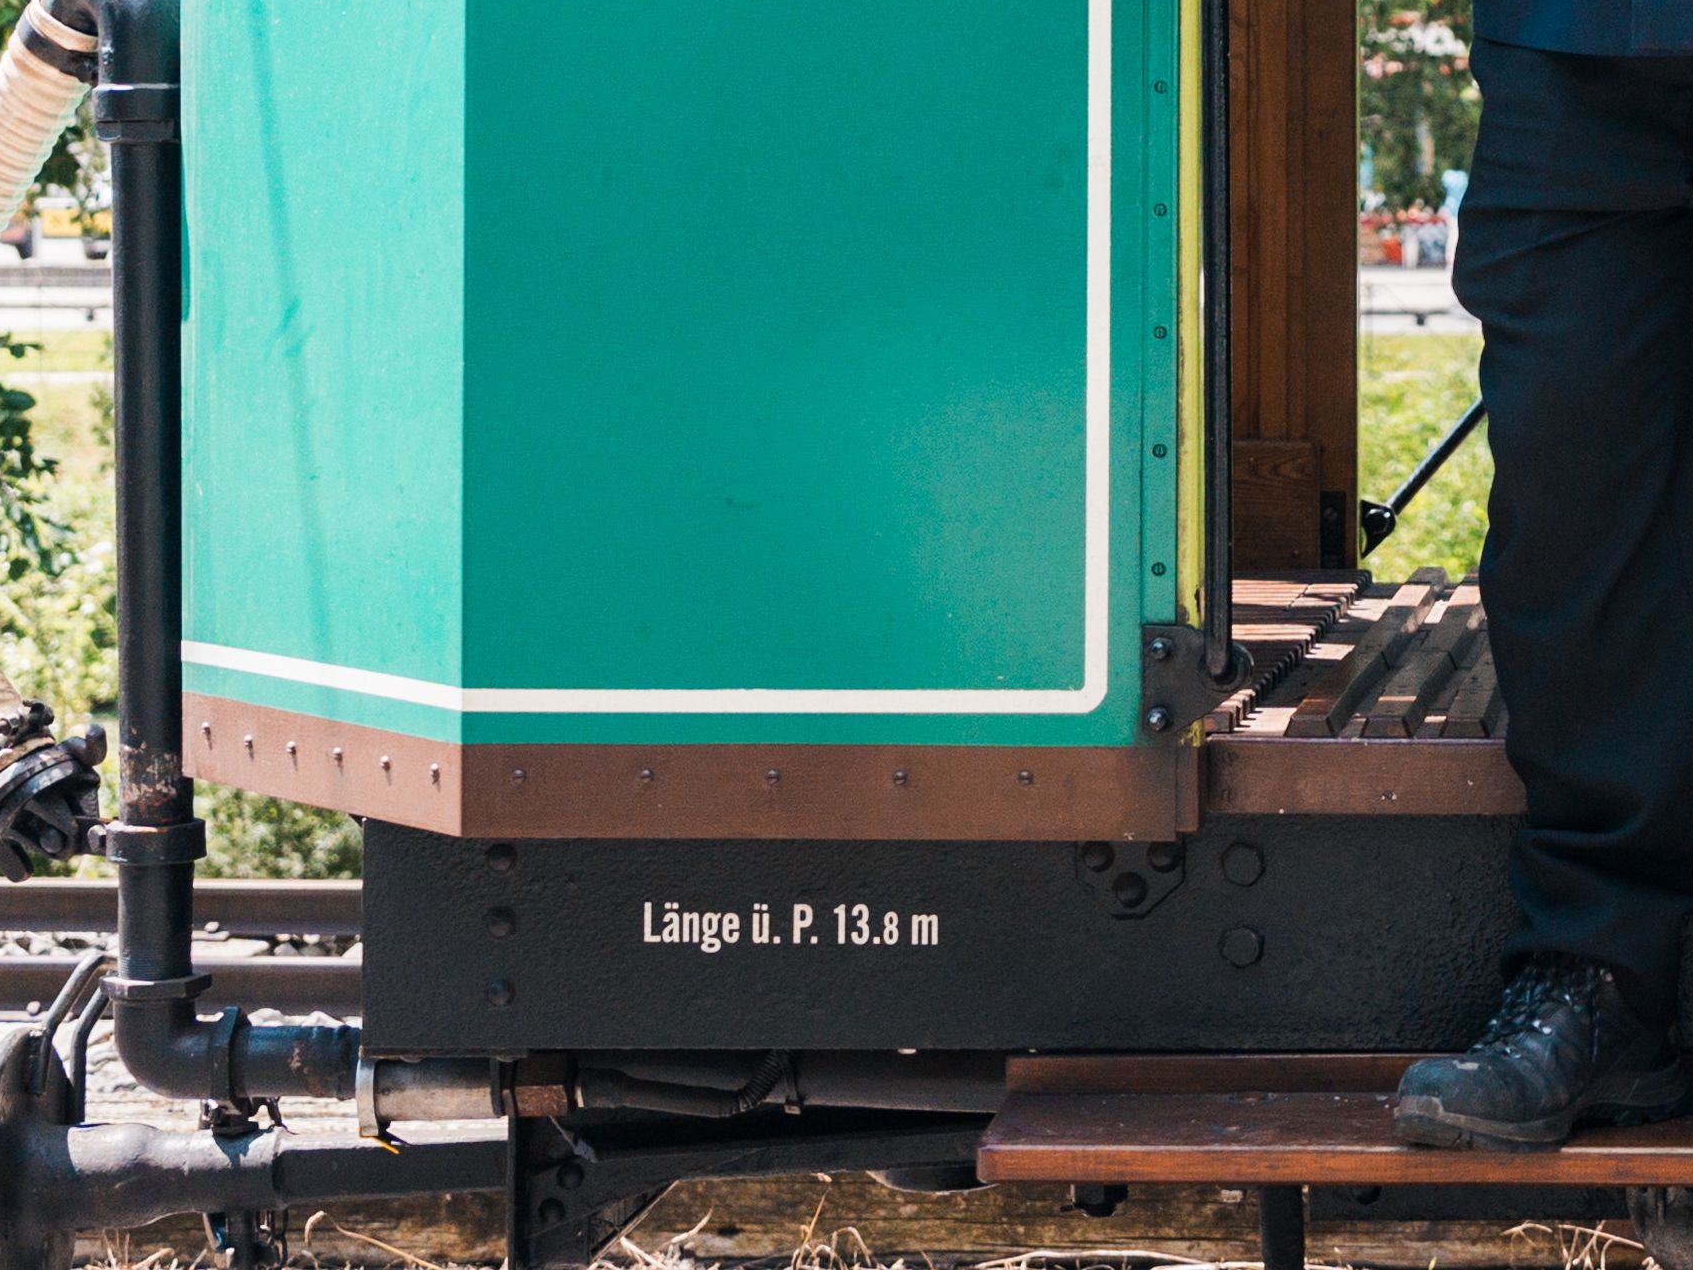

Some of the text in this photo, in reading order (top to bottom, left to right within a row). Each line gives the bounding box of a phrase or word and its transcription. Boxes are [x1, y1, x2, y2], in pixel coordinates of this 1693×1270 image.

[643, 901, 939, 954] Länge ü. P. 13.8 m
